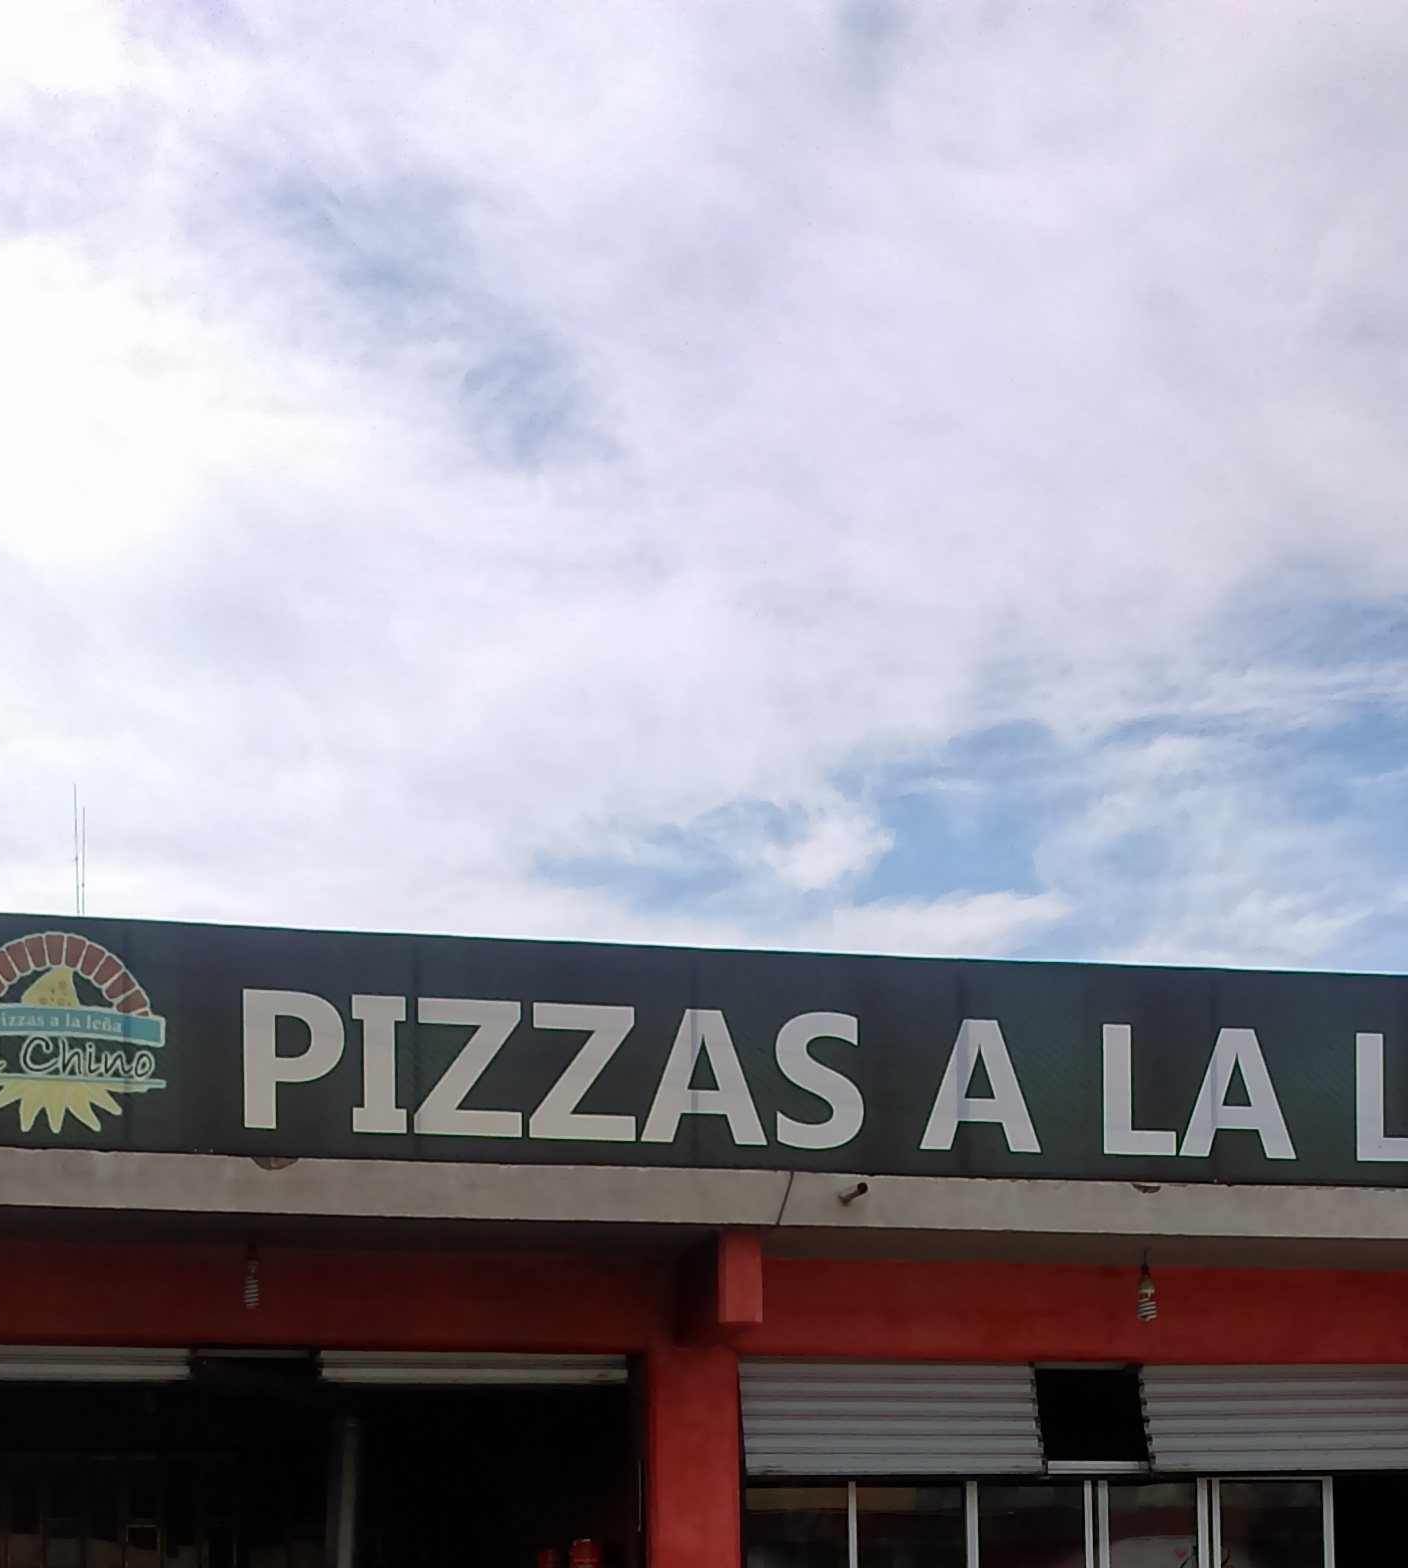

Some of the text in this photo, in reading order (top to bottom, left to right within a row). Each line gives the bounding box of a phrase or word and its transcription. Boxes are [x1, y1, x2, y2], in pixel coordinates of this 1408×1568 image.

[49, 1017, 60, 1028] a
[65, 1013, 81, 1029] la
[86, 1014, 123, 1033] leña
[20, 1034, 156, 1080] Chino
[242, 988, 867, 1151] PIZZAS
[918, 1018, 1042, 1155] A
[1101, 1023, 1298, 1161] LA
